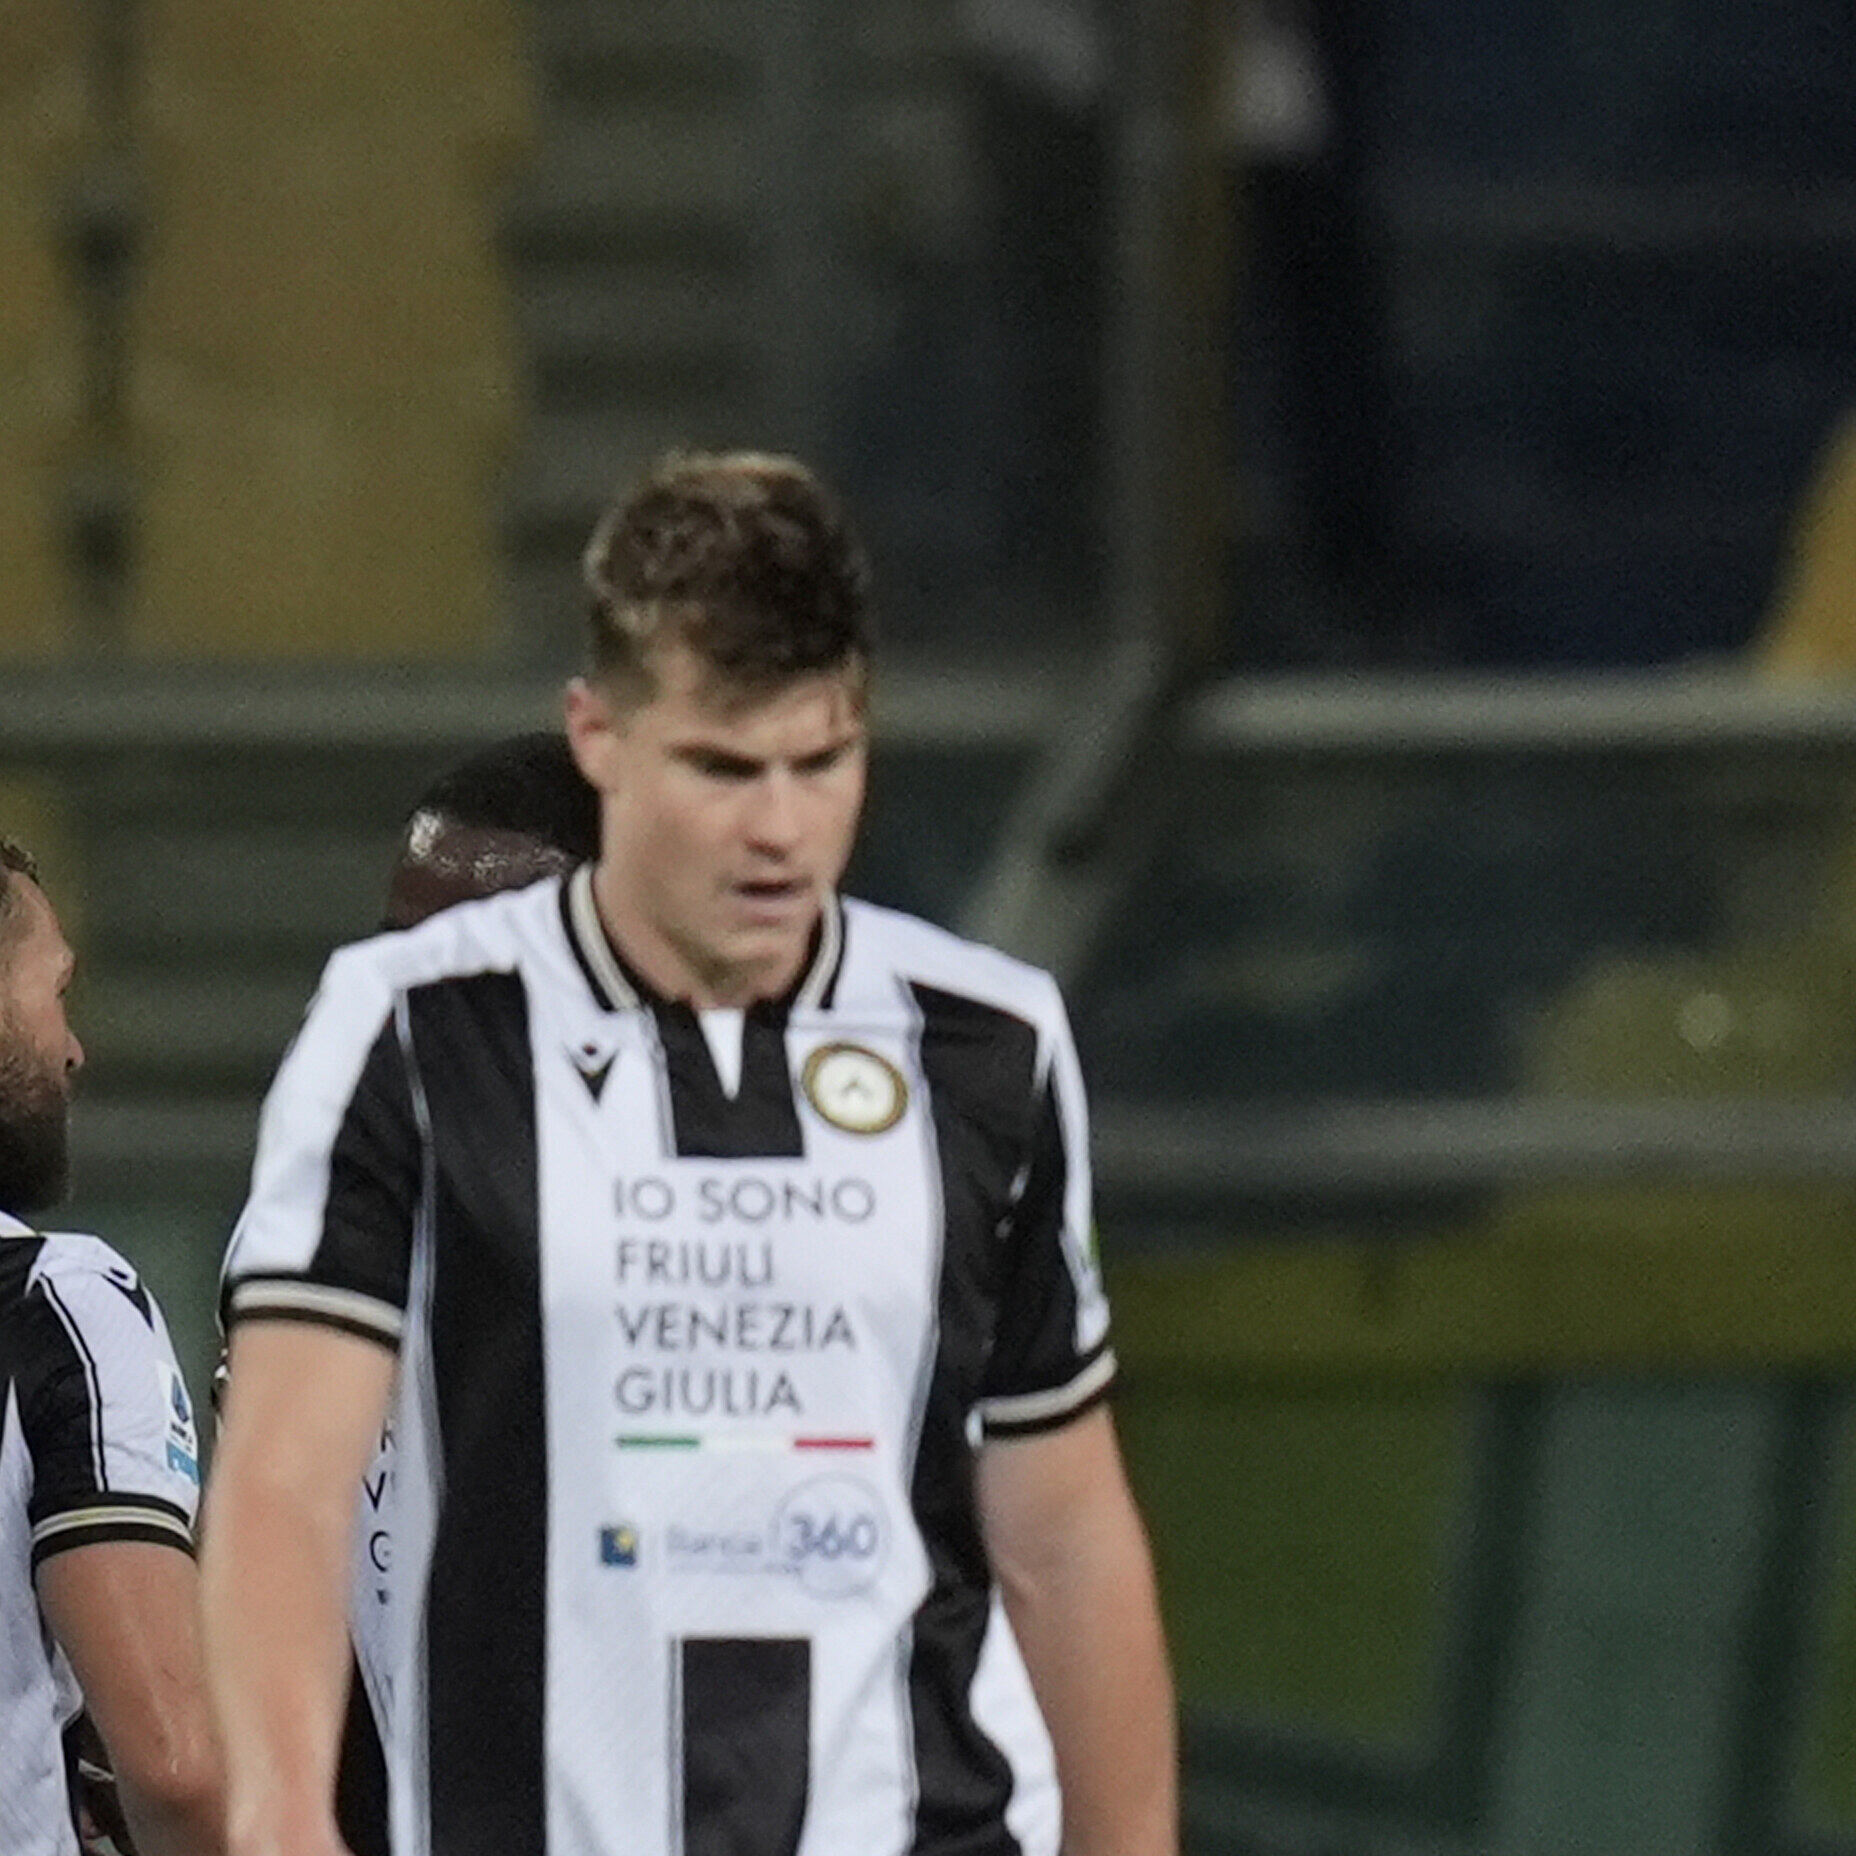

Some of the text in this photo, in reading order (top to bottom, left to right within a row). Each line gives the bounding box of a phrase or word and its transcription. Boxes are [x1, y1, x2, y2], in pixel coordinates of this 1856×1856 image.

[613, 1176, 876, 1224] IO SONO
[615, 1237, 774, 1288] FRIULI
[614, 1302, 857, 1351] VENEZIA
[613, 1366, 805, 1416] GIULIA
[790, 1513, 879, 1560] 360
